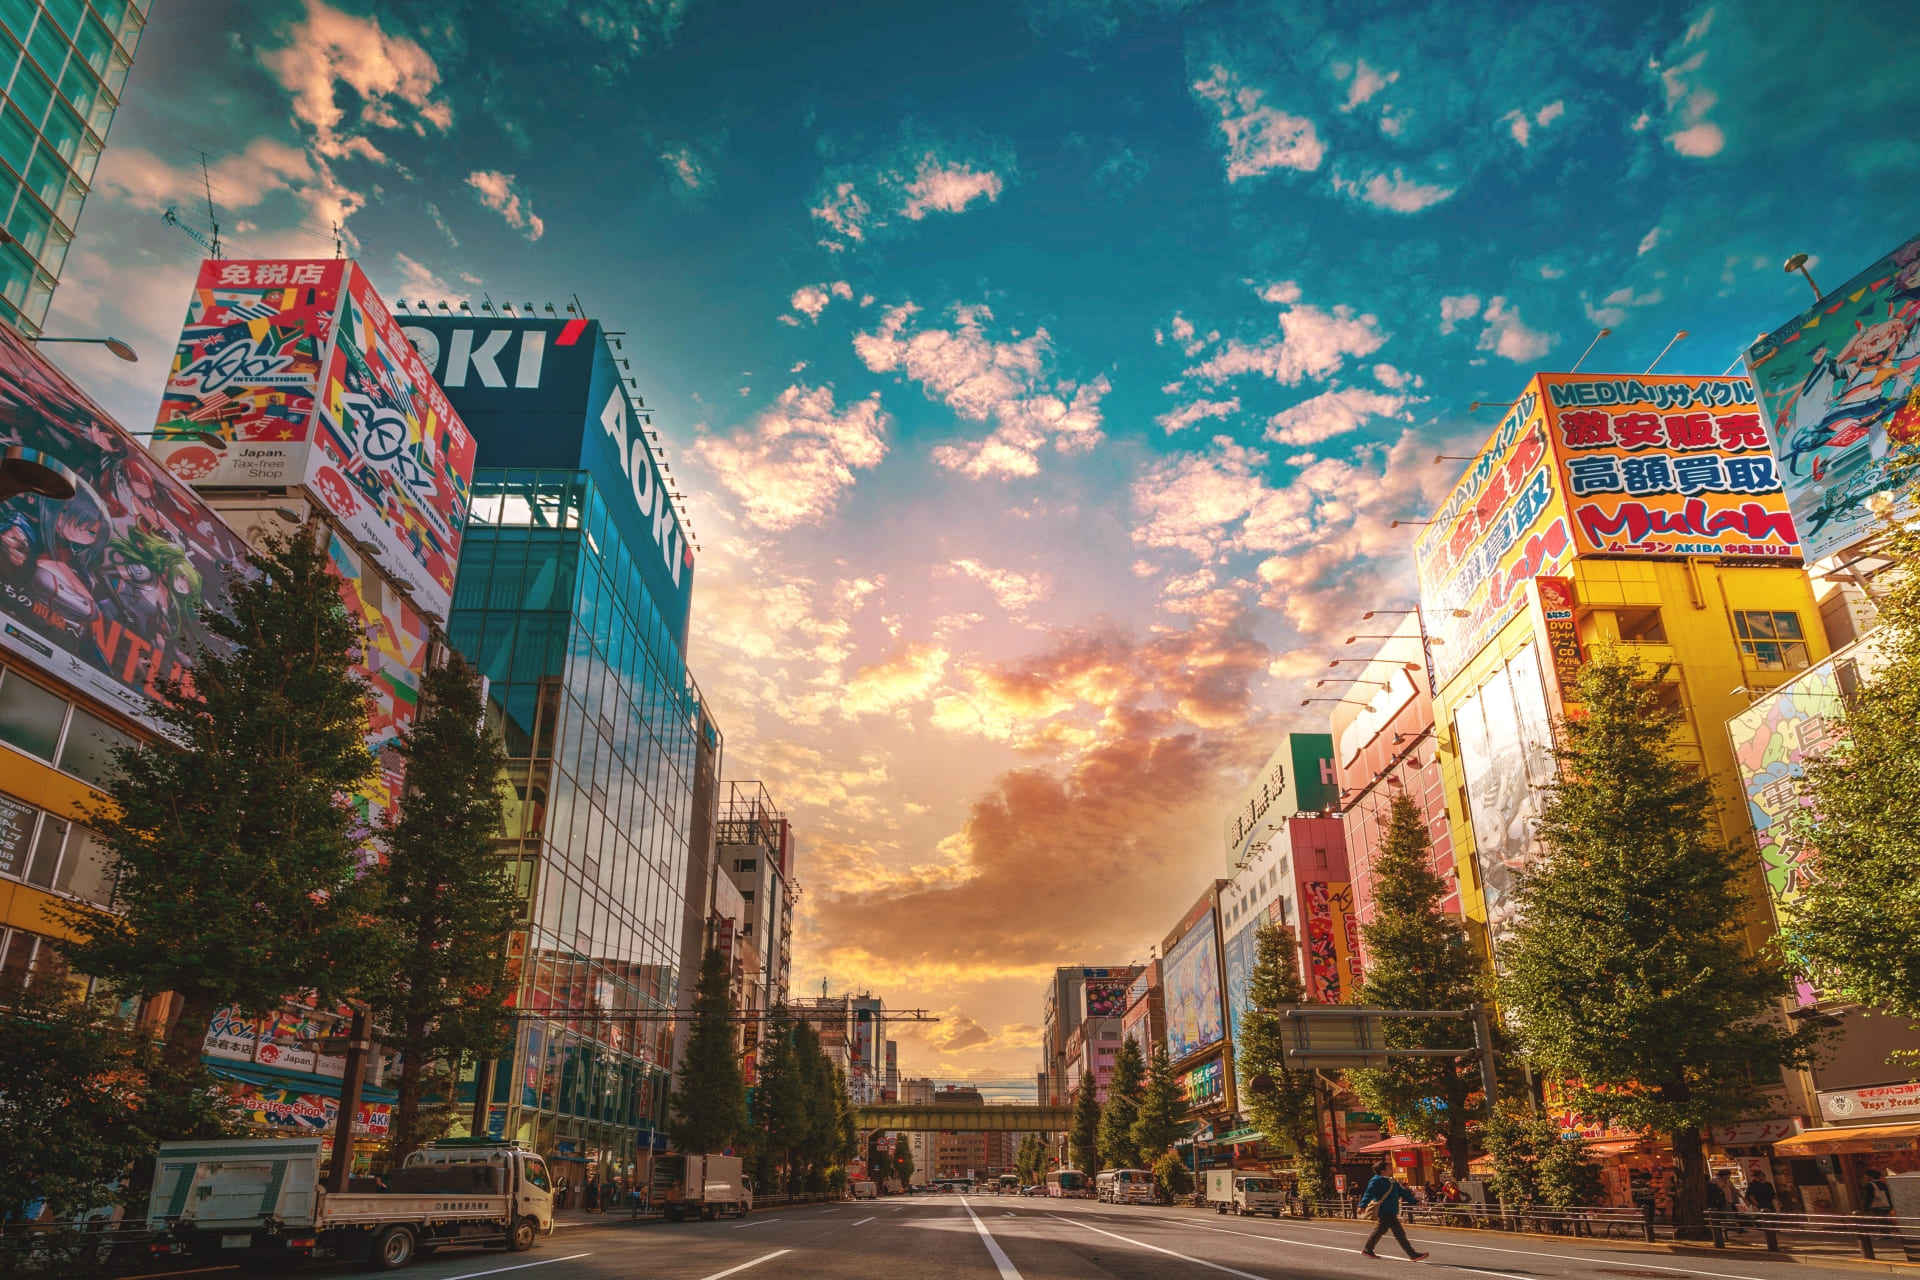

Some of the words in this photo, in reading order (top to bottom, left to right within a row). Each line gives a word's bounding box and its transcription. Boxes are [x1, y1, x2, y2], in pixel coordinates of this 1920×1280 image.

[218, 264, 326, 286] 免税店
[180, 341, 294, 391] AKKY
[233, 375, 309, 383] INTERNATIONAL
[1561, 411, 1768, 449] 激安販売
[239, 448, 286, 460] Japan.
[231, 459, 285, 470] Tax-free
[248, 468, 283, 480] Shop
[1568, 456, 1778, 494] 高額買取
[600, 384, 684, 589] AOKI
[391, 462, 448, 536] INTERNATIONAL
[1576, 498, 1799, 546] Mulan
[1608, 541, 1672, 552] ムーラン
[1675, 543, 1723, 553] AKIBA
[361, 521, 390, 556] Japan.
[426, 590, 443, 613] Shop
[1550, 621, 1573, 630] DVD
[1552, 639, 1578, 648] ゲーム
[1559, 648, 1575, 656] CD
[284, 1053, 313, 1066] Japan.
[242, 1099, 292, 1113] Tax-free
[293, 1103, 320, 1118] Shop
[1723, 1123, 1790, 1142] ラーメン
